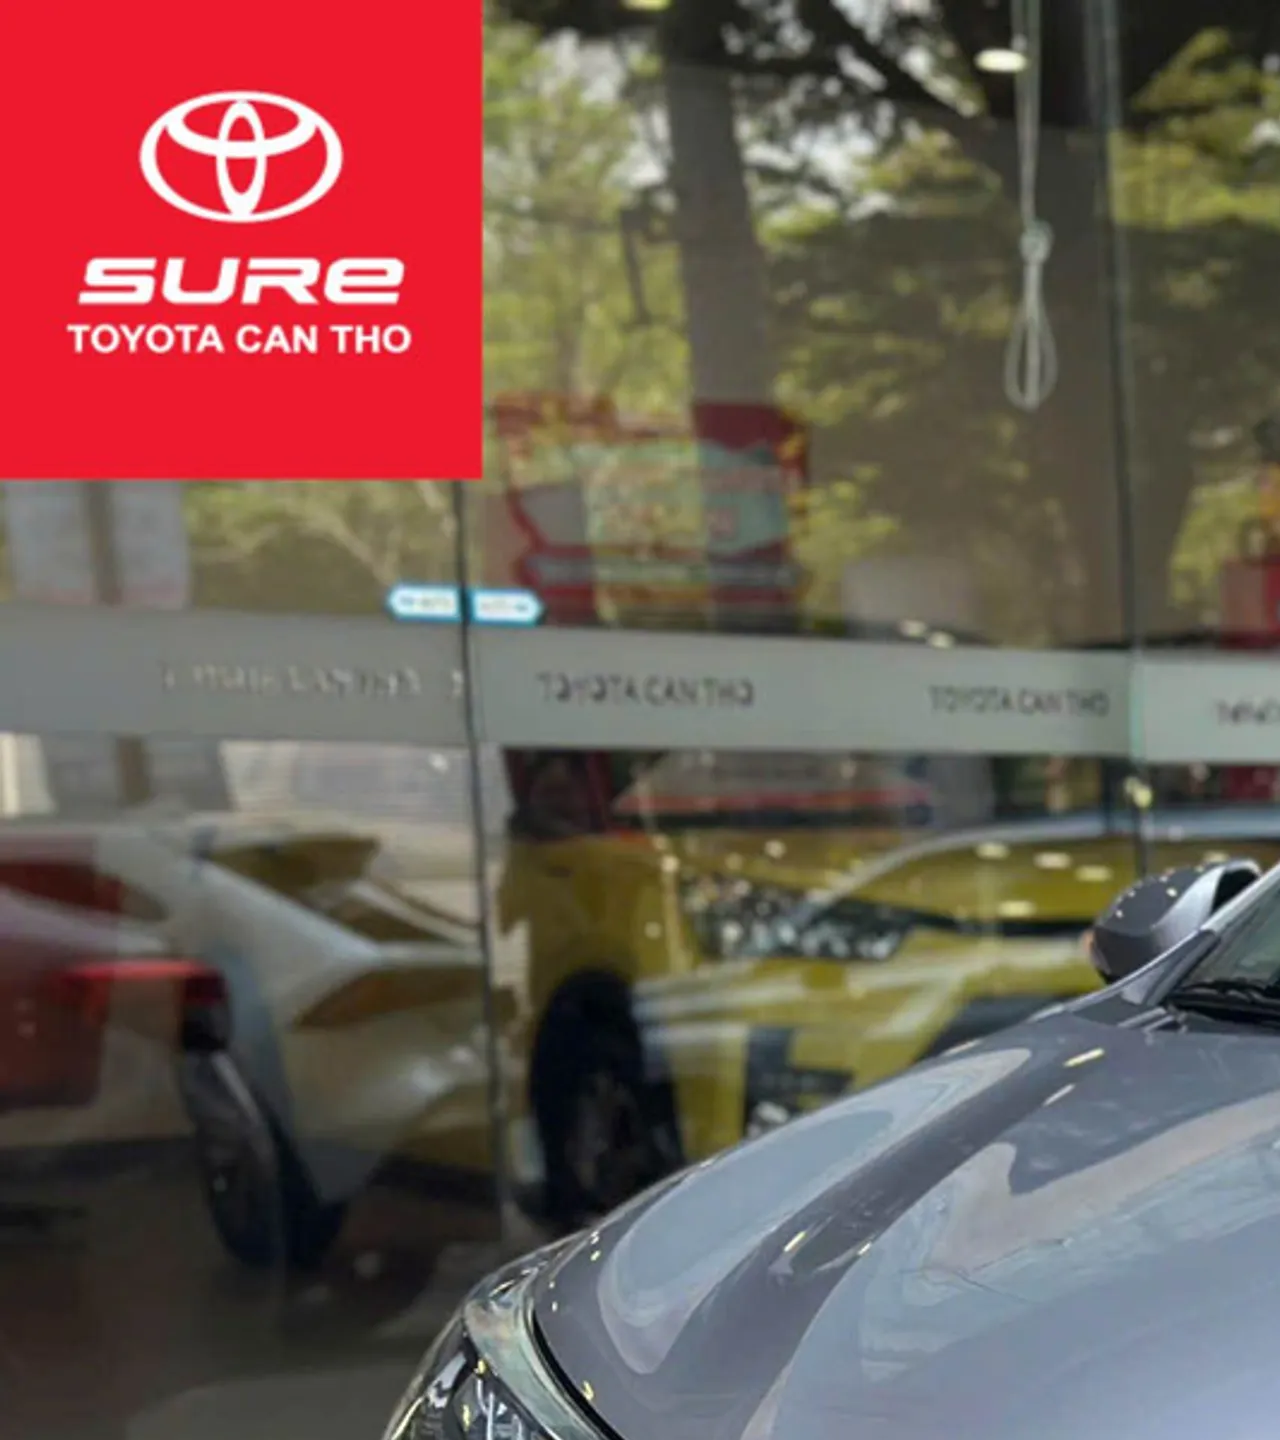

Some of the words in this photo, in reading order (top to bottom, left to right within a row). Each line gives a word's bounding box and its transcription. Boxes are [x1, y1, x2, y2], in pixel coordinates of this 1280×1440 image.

[535, 669, 641, 705] TOYOTA
[645, 673, 699, 707] CAN
[702, 675, 757, 709] THO
